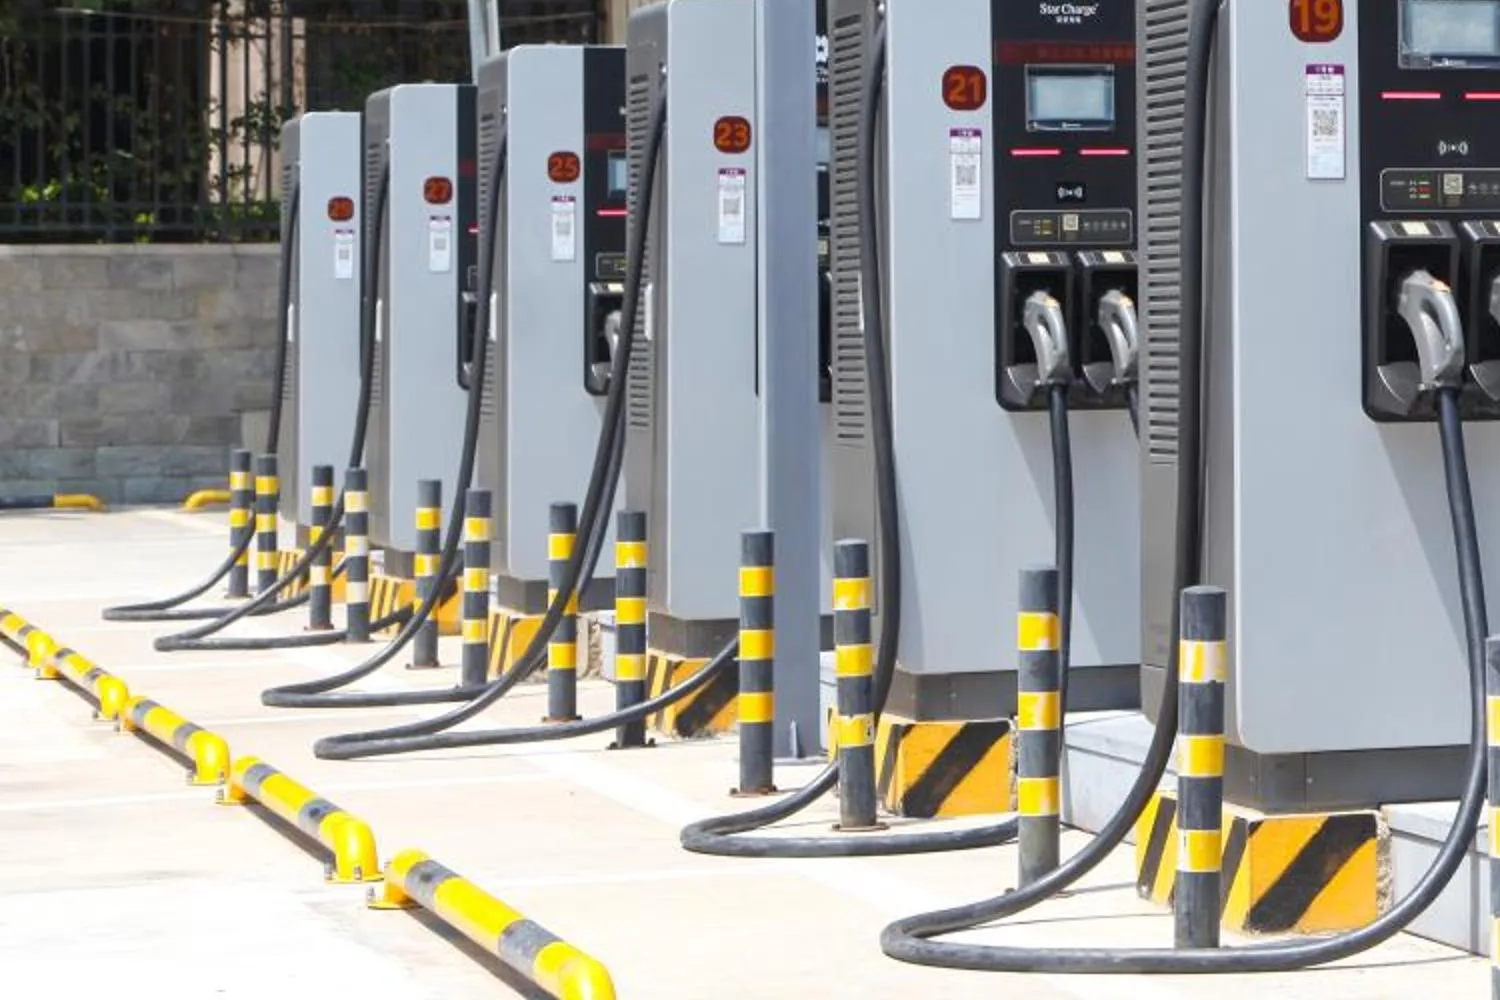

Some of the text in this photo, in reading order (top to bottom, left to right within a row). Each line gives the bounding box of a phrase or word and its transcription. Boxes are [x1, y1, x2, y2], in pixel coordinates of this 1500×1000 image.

[948, 72, 981, 103] 21
[716, 122, 748, 147] 23
[551, 156, 577, 178] 25
